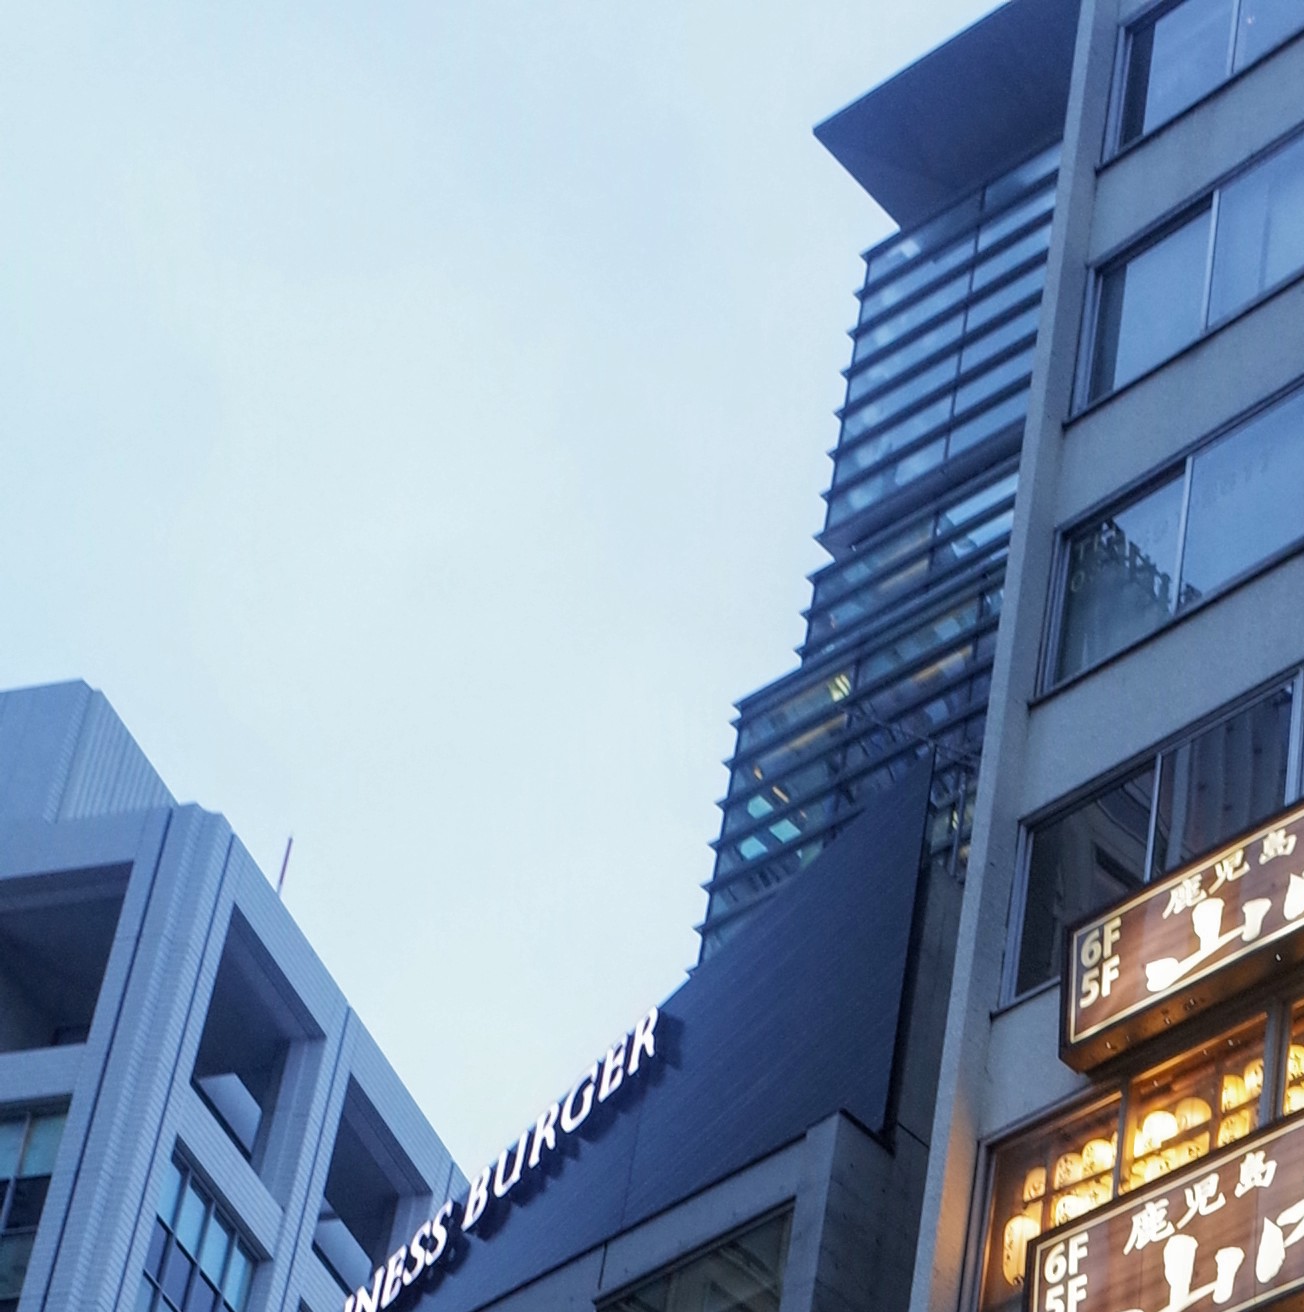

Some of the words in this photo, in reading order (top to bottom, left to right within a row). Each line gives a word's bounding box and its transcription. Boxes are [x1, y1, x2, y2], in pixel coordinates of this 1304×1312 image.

[1163, 830, 1297, 920] 鹿児島
[1080, 917, 1123, 970] 6F
[1079, 955, 1121, 1009] 5F
[460, 1006, 659, 1231] BURGER
[1123, 1151, 1277, 1255] 鹿児島
[1044, 1234, 1089, 1283] 6F
